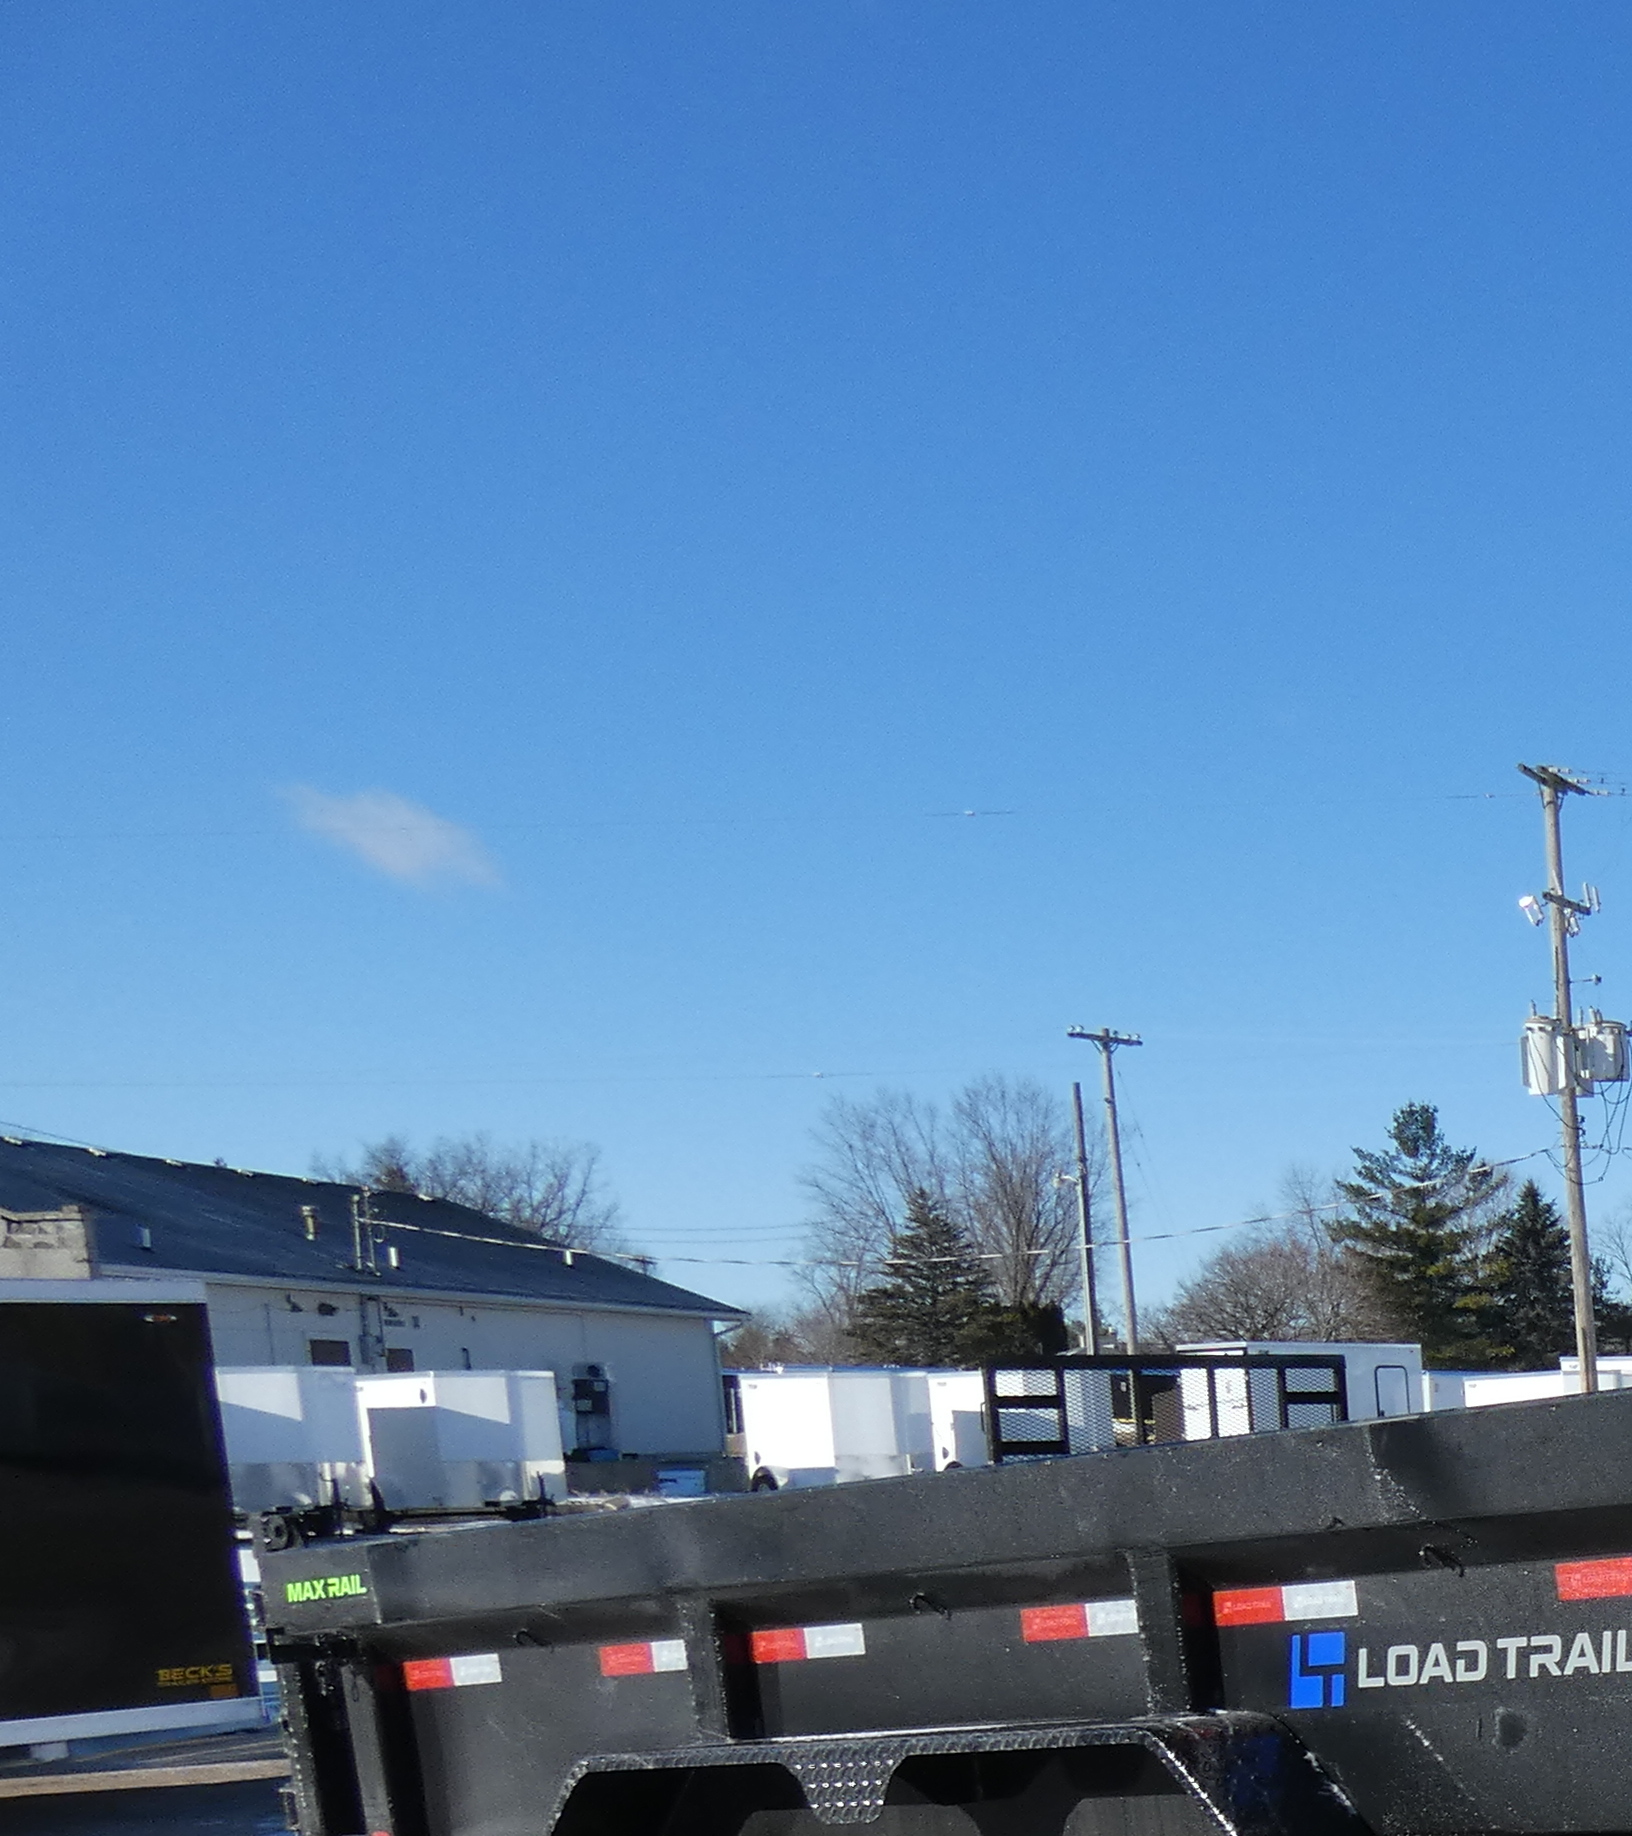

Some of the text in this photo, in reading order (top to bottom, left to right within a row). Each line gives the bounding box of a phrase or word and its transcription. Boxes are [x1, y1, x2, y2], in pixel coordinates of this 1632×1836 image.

[286, 1574, 368, 1603] MAX RAIL
[1358, 1640, 1488, 1688] LOAD
